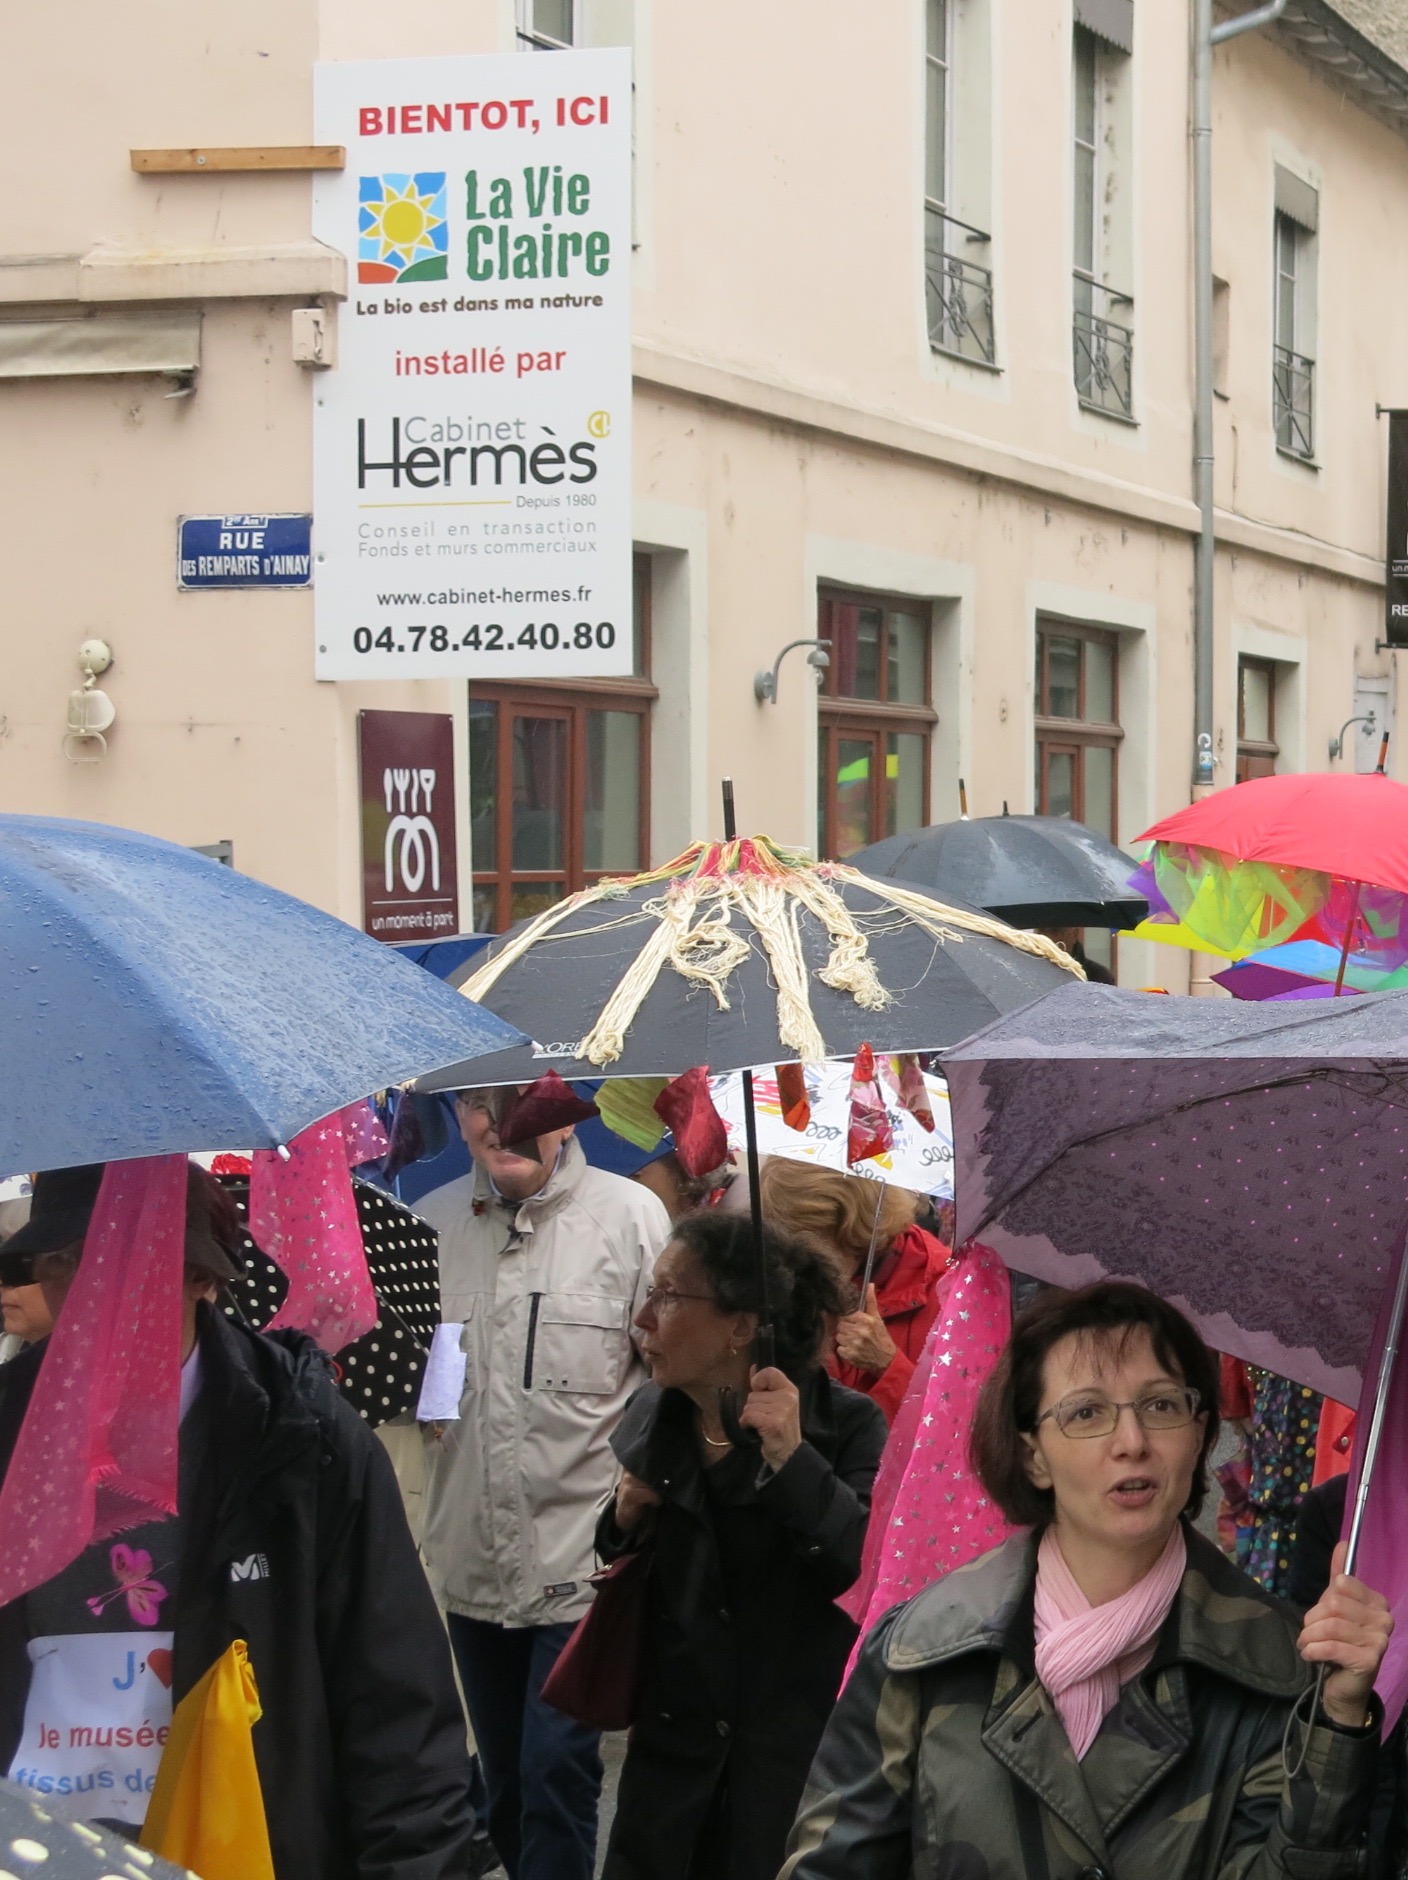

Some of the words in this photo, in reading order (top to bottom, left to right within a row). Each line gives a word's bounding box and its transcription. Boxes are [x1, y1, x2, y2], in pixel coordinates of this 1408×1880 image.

[359, 99, 541, 136] BIENTOT,
[556, 96, 610, 127] ICI
[465, 169, 513, 220] La
[523, 165, 590, 218] Vie
[466, 223, 610, 281] Claire
[356, 300, 378, 316] La
[384, 298, 413, 315] bio
[419, 297, 448, 313] est
[453, 296, 499, 312] dans
[504, 296, 534, 310] ma
[540, 293, 604, 309] nature
[395, 347, 505, 376] installé
[516, 351, 567, 379] par
[404, 416, 527, 444] Cabinet
[357, 416, 598, 489] Hermès
[515, 494, 561, 510] Depuis
[565, 494, 597, 508] 1980
[219, 532, 265, 550] RUE
[357, 521, 435, 539] Conseil
[447, 523, 470, 537] en
[483, 518, 597, 535] transaction
[357, 541, 409, 558] Fonds
[415, 542, 432, 556] et
[436, 542, 478, 556] murs
[483, 538, 598, 556] commerciaux
[182, 559, 197, 577] DES
[198, 556, 260, 577] REMPARTS
[1391, 564, 1403, 573] un
[376, 584, 592, 606] www.cabinet-hermes.fr
[353, 621, 616, 654] 04.78.42.40.80
[371, 917, 385, 931] un
[385, 913, 426, 929] moment
[425, 911, 433, 928] à
[433, 911, 454, 931] part
[112, 1650, 147, 1690] J'
[69, 1719, 171, 1748] musée
[16, 1766, 114, 1795] tissus
